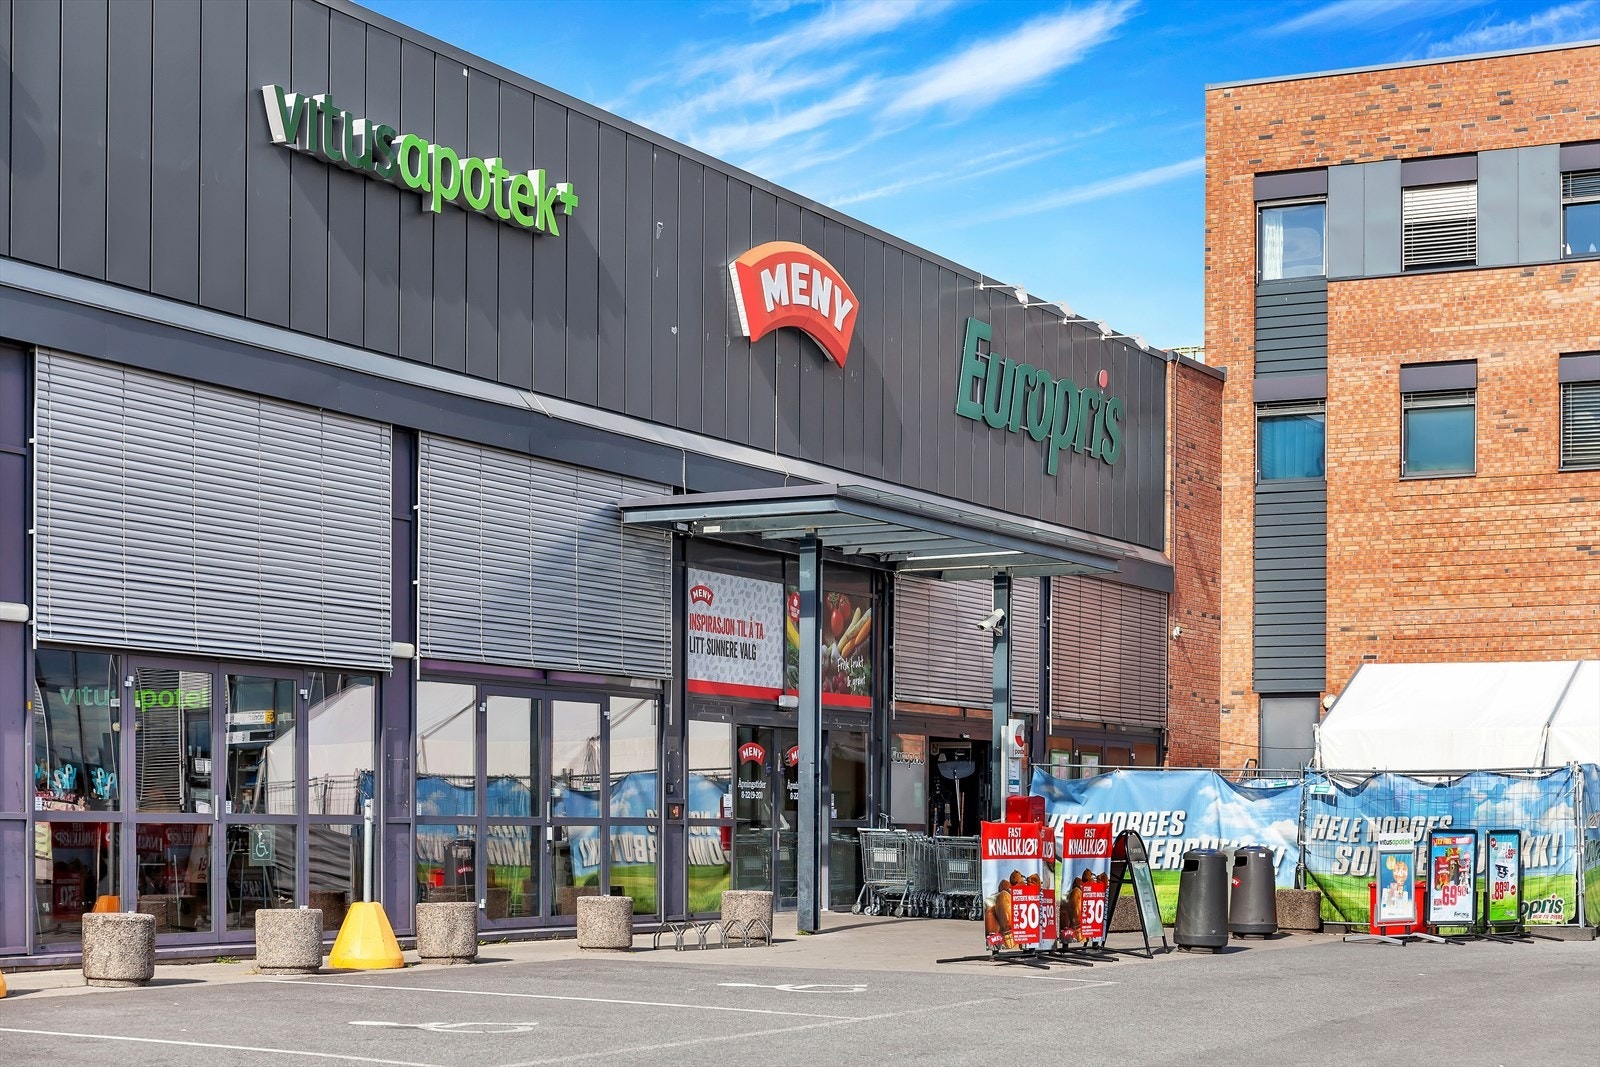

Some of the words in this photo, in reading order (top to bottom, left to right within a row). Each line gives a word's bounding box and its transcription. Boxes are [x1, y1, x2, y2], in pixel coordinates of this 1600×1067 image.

[760, 262, 853, 332] MENY
[956, 316, 1122, 476] Europris
[692, 589, 712, 600] MENY
[689, 613, 735, 636] INSPIRASJON
[737, 619, 747, 637] TIL
[749, 616, 754, 638] Å
[755, 622, 764, 640] TA
[689, 636, 704, 654] LITT
[706, 638, 738, 659] SUNNERE
[740, 642, 757, 661] VALG
[742, 747, 763, 759] MENY
[1008, 827, 1021, 837] FAST
[1084, 828, 1096, 838] FAST
[1311, 814, 1363, 843] HELE
[1019, 903, 1039, 929] 30
[1086, 899, 1104, 924] 30
